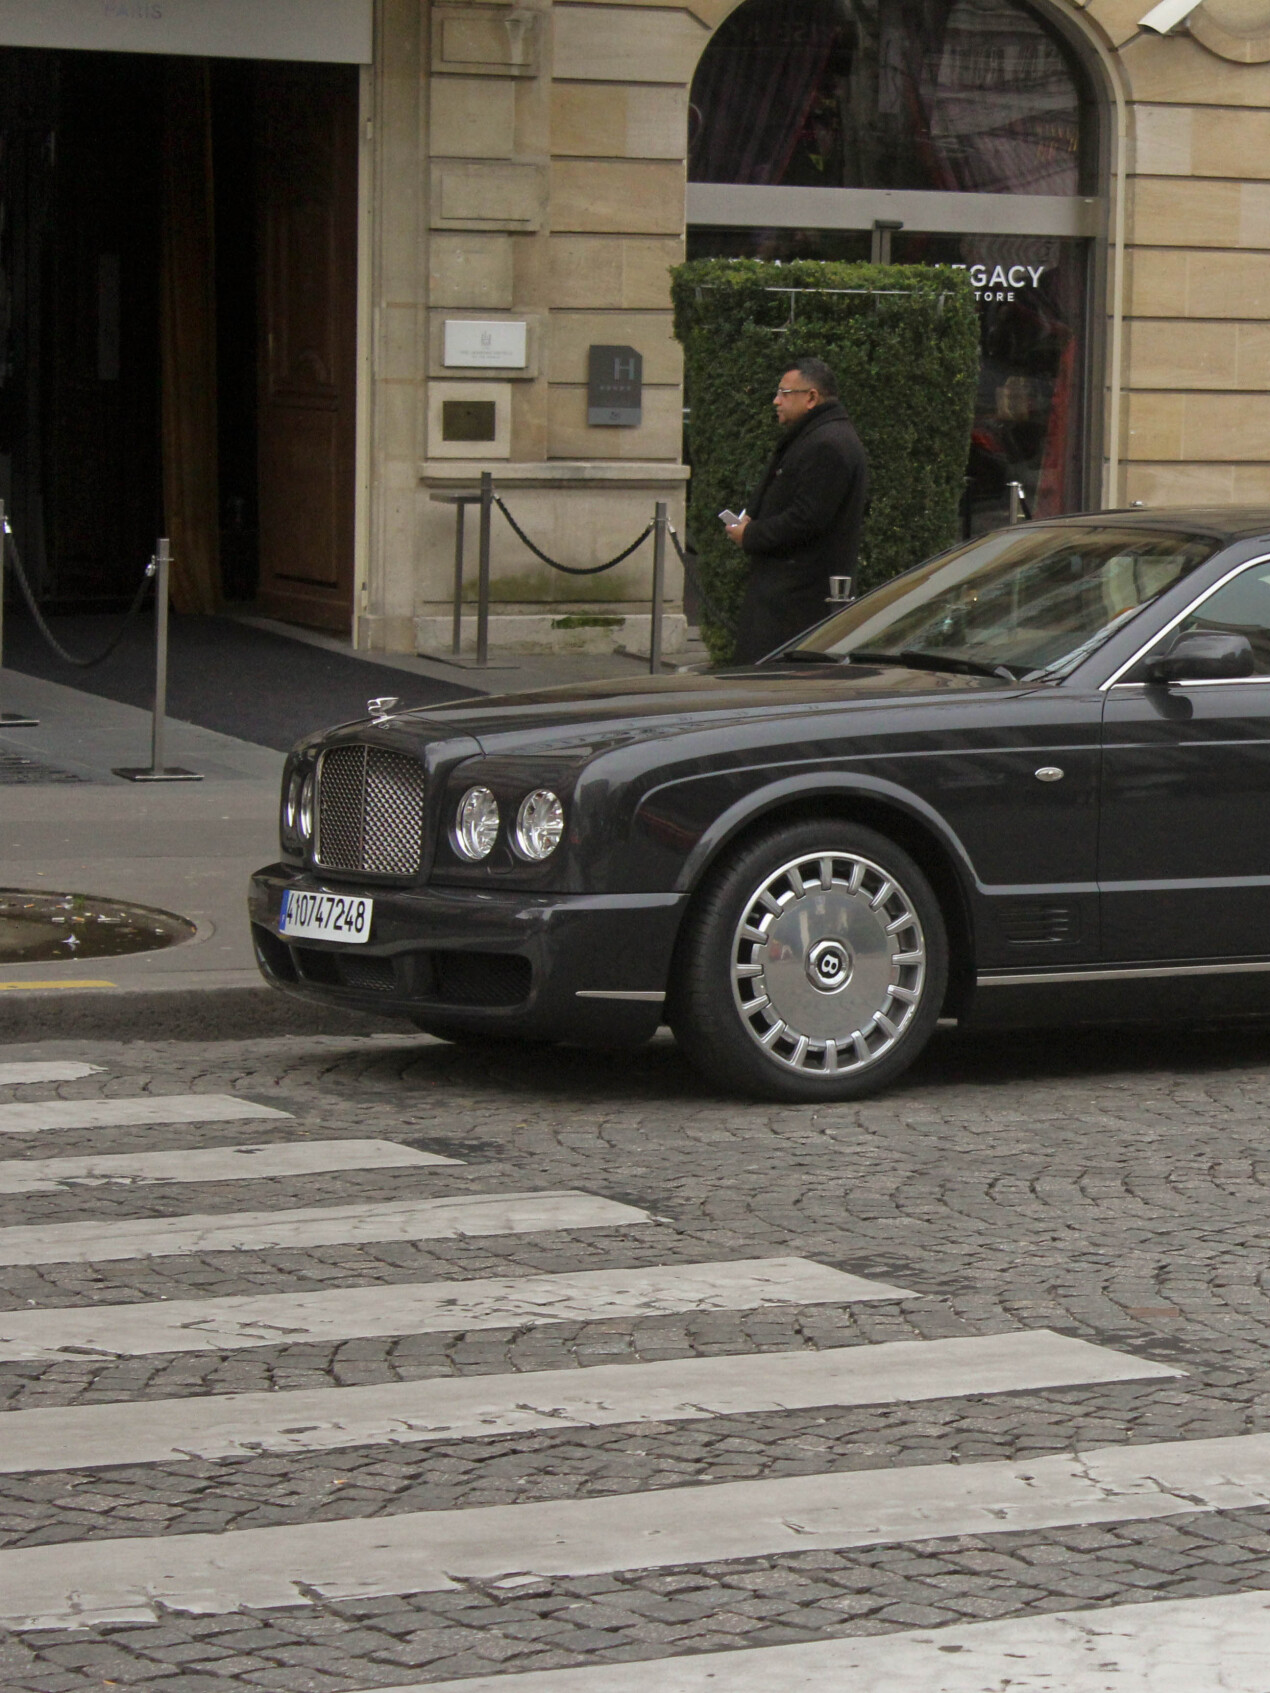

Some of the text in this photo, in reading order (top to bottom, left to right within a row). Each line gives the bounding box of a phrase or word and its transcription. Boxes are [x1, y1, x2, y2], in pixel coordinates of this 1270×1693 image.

[974, 291, 1015, 302] TORE
[614, 357, 635, 380] H
[286, 893, 366, 933] 410747248
